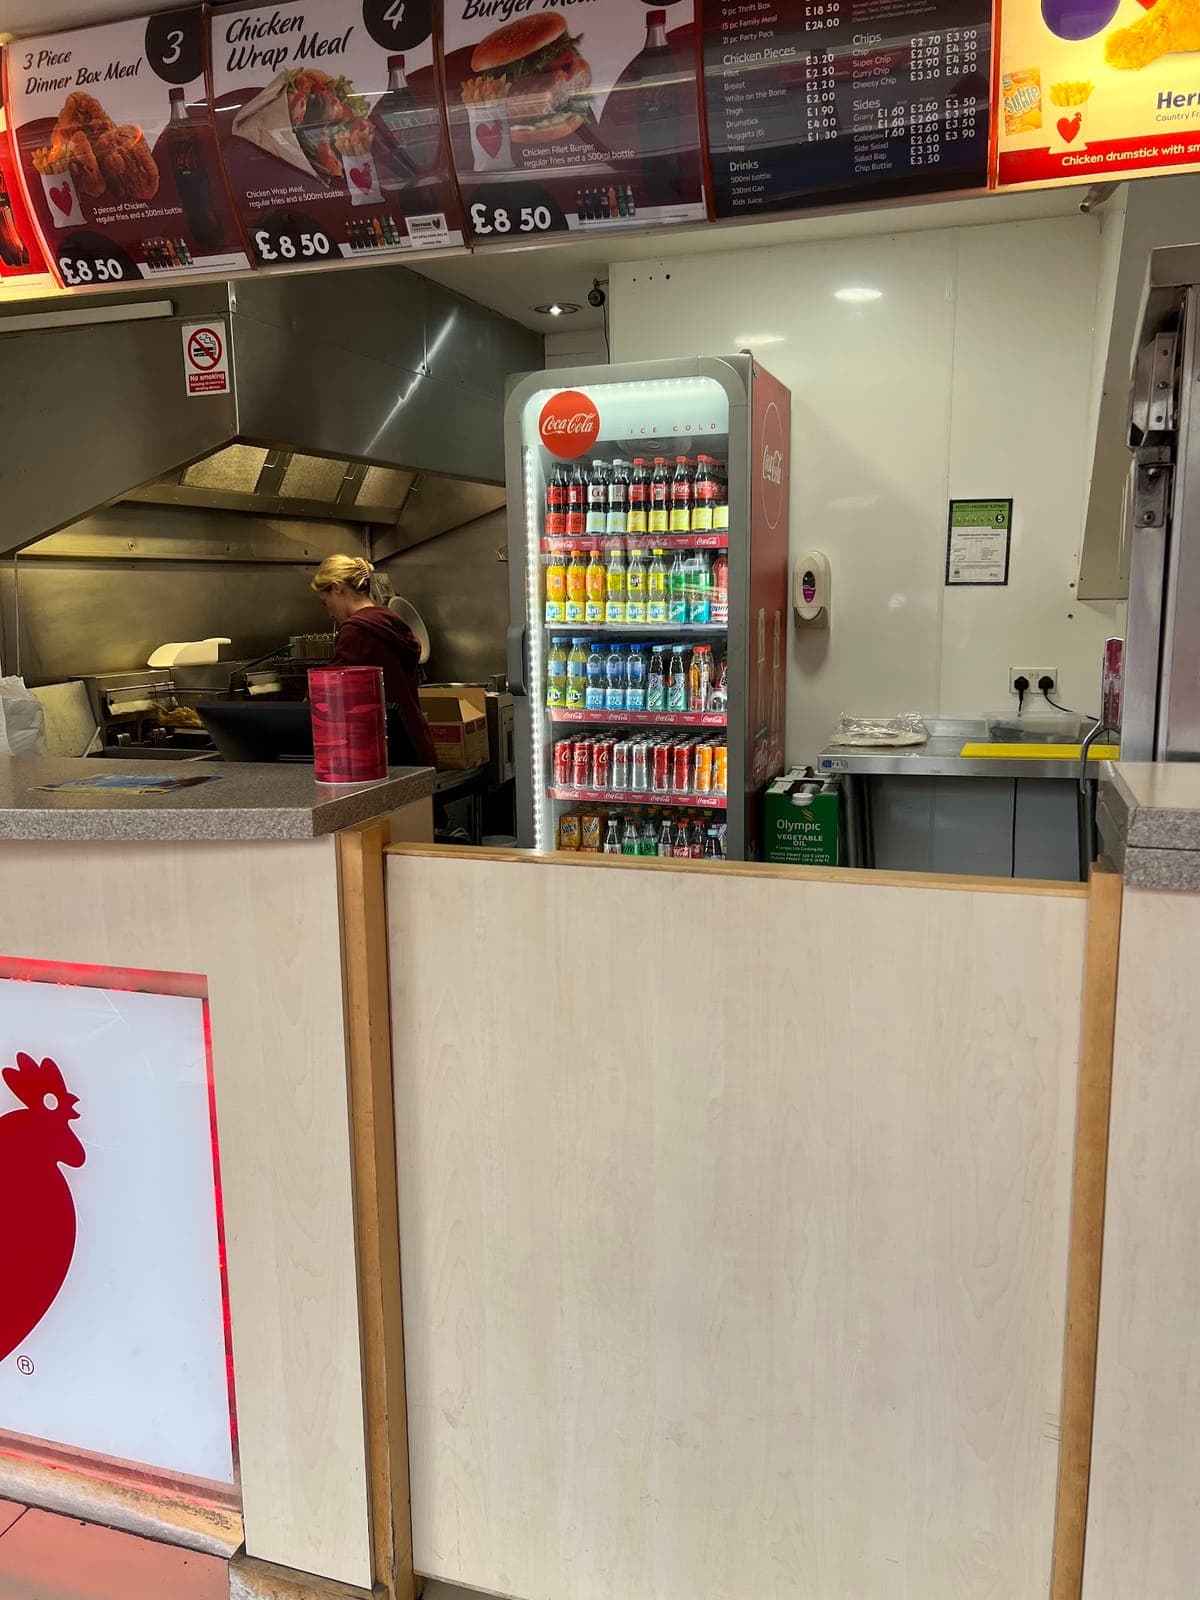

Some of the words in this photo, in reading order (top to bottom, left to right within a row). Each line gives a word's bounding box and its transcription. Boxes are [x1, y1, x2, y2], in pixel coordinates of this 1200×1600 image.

[383, 0, 406, 31] 4
[462, 0, 532, 21] Burger
[226, 11, 305, 44] Chicken
[806, 18, 840, 31] £24.00
[853, 32, 882, 46] Chips
[911, 36, 940, 48] £2.70
[946, 30, 976, 43] £3.90
[162, 31, 184, 65] 3
[226, 45, 288, 73] Wrap
[293, 26, 354, 61] Meal
[911, 47, 940, 59] £2.90
[946, 42, 976, 54] £4.50
[23, 53, 33, 70] 3
[37, 50, 72, 69] Piece
[724, 52, 762, 65] Chicken
[764, 47, 796, 59] Pieces
[806, 54, 834, 66] £3.20
[852, 60, 874, 69] Super
[874, 56, 892, 64] Chip
[25, 76, 72, 95] Dinner
[75, 67, 102, 86] Box
[104, 57, 143, 81] Meal
[852, 70, 872, 79] Curry
[873, 66, 890, 75] Chip
[806, 80, 835, 92] £2.20
[880, 77, 896, 86] Chip
[853, 99, 880, 111] Sides
[1157, 91, 1200, 110] Her
[1156, 113, 1190, 122] Country
[522, 146, 550, 158] Chicken
[551, 144, 568, 154] Fillet
[1062, 154, 1104, 166] Chicken
[1106, 147, 1158, 162] drumstick
[1162, 144, 1184, 155] with
[524, 157, 548, 168] regular
[550, 154, 566, 164] fries
[567, 154, 580, 163] and
[587, 151, 611, 162] 500ml
[612, 149, 635, 159] bottle
[730, 160, 760, 172] Drinks
[246, 190, 271, 199] Chicken
[271, 187, 288, 196] Wrap
[249, 199, 270, 208] regular
[270, 196, 285, 204] fries
[286, 195, 298, 204] and
[302, 192, 323, 202] 500ml
[324, 190, 344, 199] bottle
[96, 214, 116, 224] regular
[130, 211, 141, 220] and
[146, 208, 164, 218] 500ml
[164, 206, 184, 216] bottle
[98, 206, 116, 216] pieces
[116, 204, 123, 212] of
[541, 412, 597, 436] Coca-Cola
[672, 423, 717, 432] COLD
[776, 819, 821, 832] Olympic
[777, 834, 823, 842] VEGETABLE
